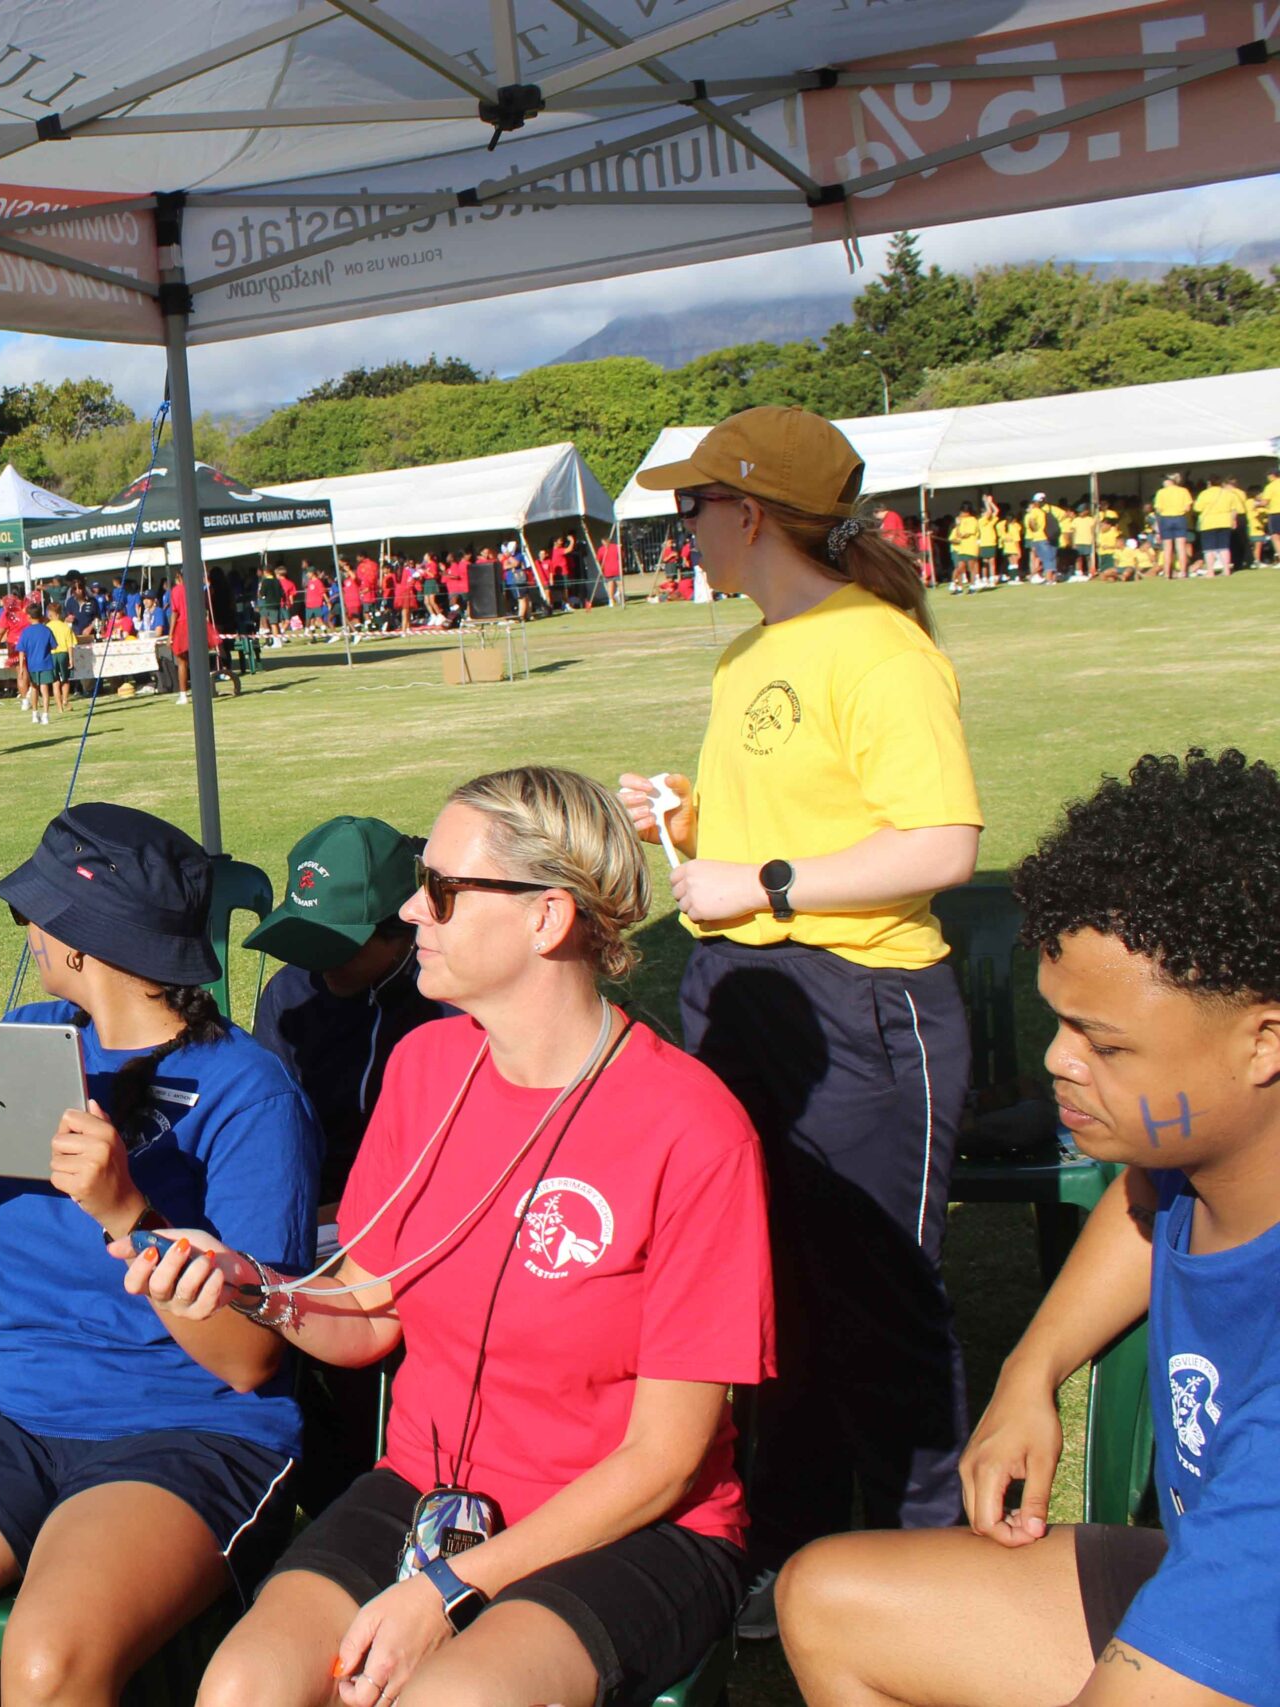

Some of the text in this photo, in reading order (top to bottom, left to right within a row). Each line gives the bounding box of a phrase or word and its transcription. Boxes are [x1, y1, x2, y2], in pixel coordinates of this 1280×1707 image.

[203, 507, 329, 528] BERGVLIET PRIMARY SCHOOL
[31, 529, 88, 550] BERGVLIET
[89, 523, 139, 540] PRIMARY
[1139, 1091, 1209, 1149] H
